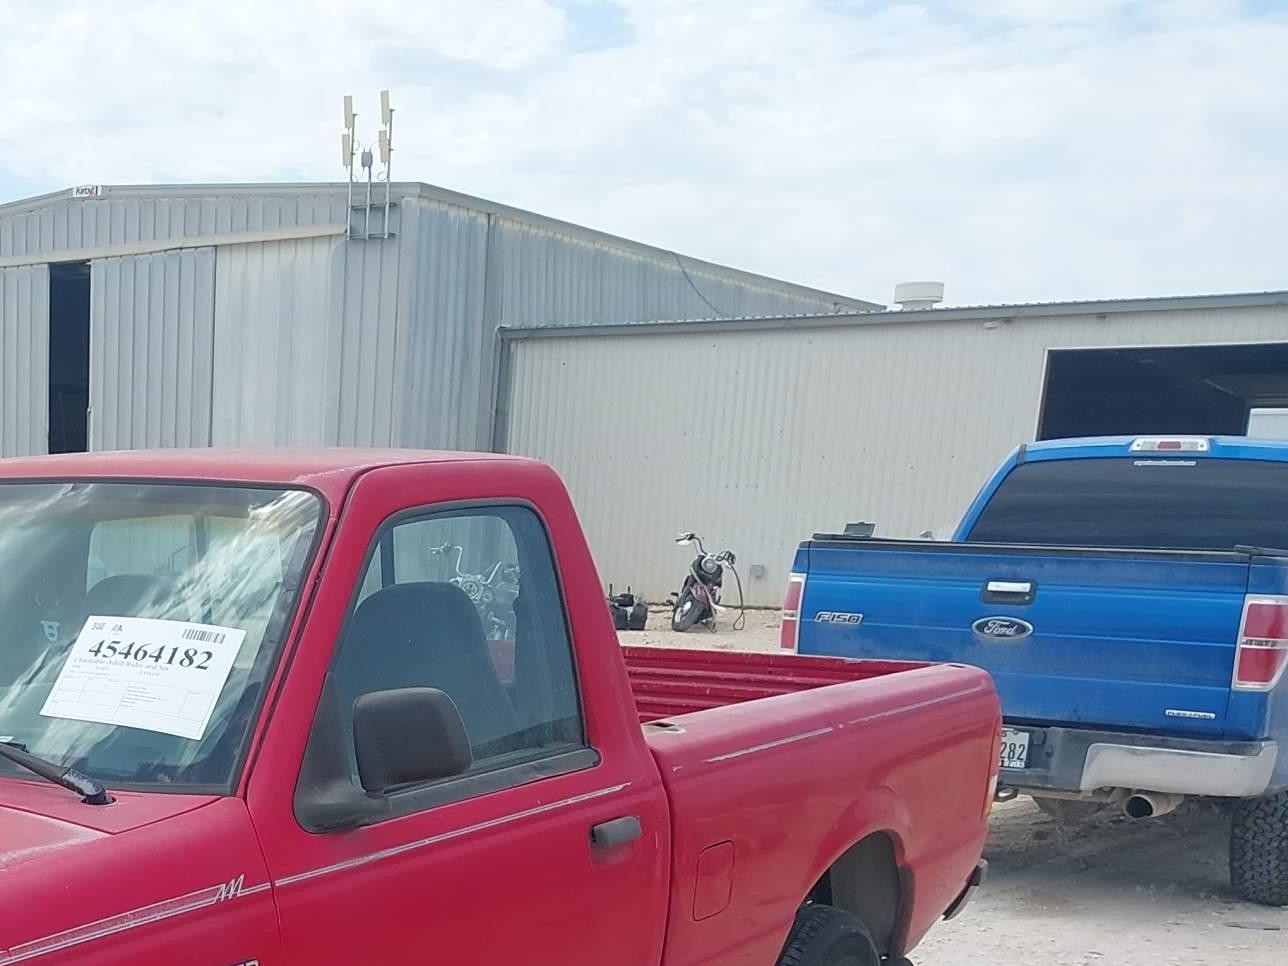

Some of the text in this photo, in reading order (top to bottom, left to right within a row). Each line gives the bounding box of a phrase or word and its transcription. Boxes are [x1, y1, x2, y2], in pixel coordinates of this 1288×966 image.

[984, 620, 1018, 636] Ford
[88, 639, 214, 671] 45464182
[1000, 742, 1026, 760] 282
